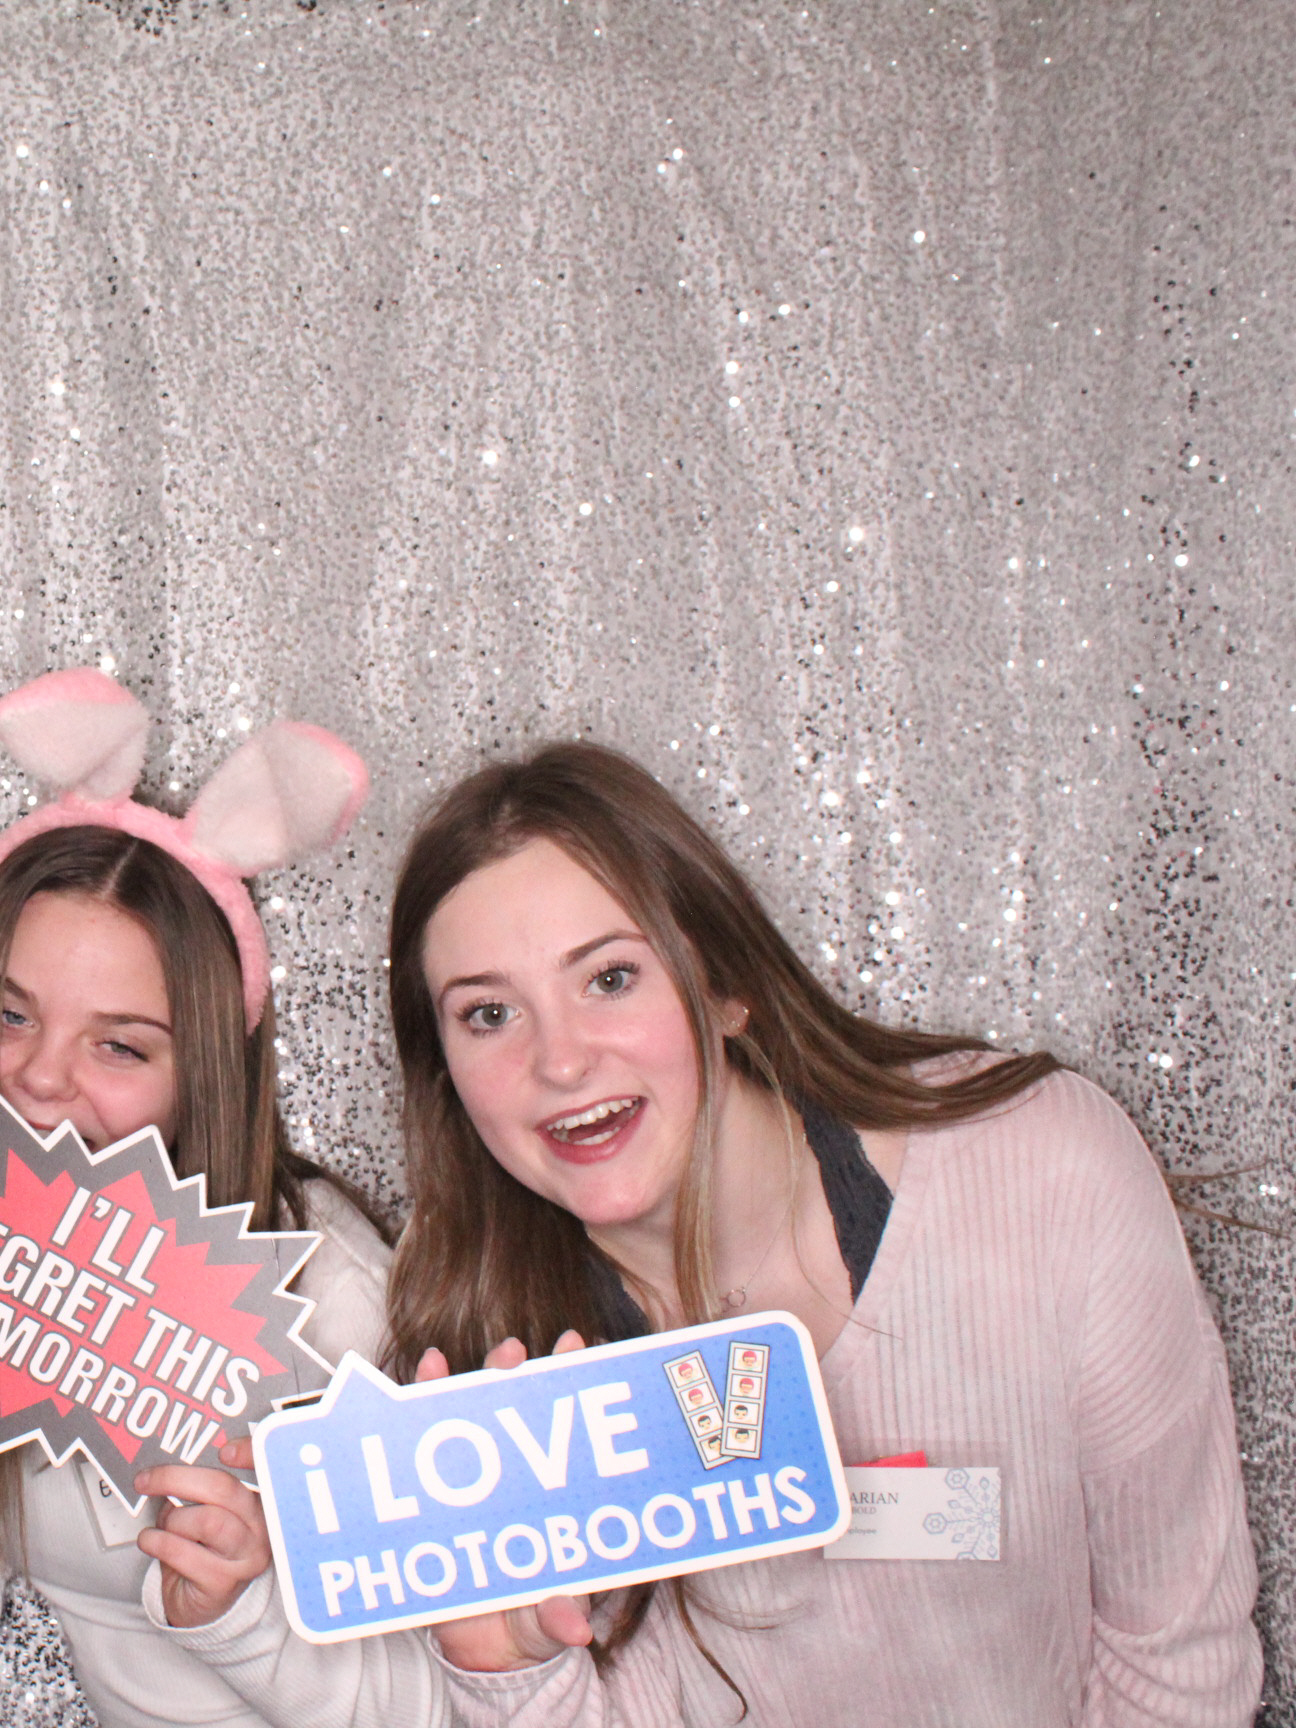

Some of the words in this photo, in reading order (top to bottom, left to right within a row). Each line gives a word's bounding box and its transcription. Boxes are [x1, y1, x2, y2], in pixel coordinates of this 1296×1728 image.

[52, 1187, 167, 1295] I'LL
[133, 1308, 260, 1417] THIS
[299, 1443, 340, 1535] i
[361, 1381, 649, 1523] LOVE
[850, 1492, 899, 1504] ARIAN
[318, 1465, 816, 1617] PHOTOBOOTHS
